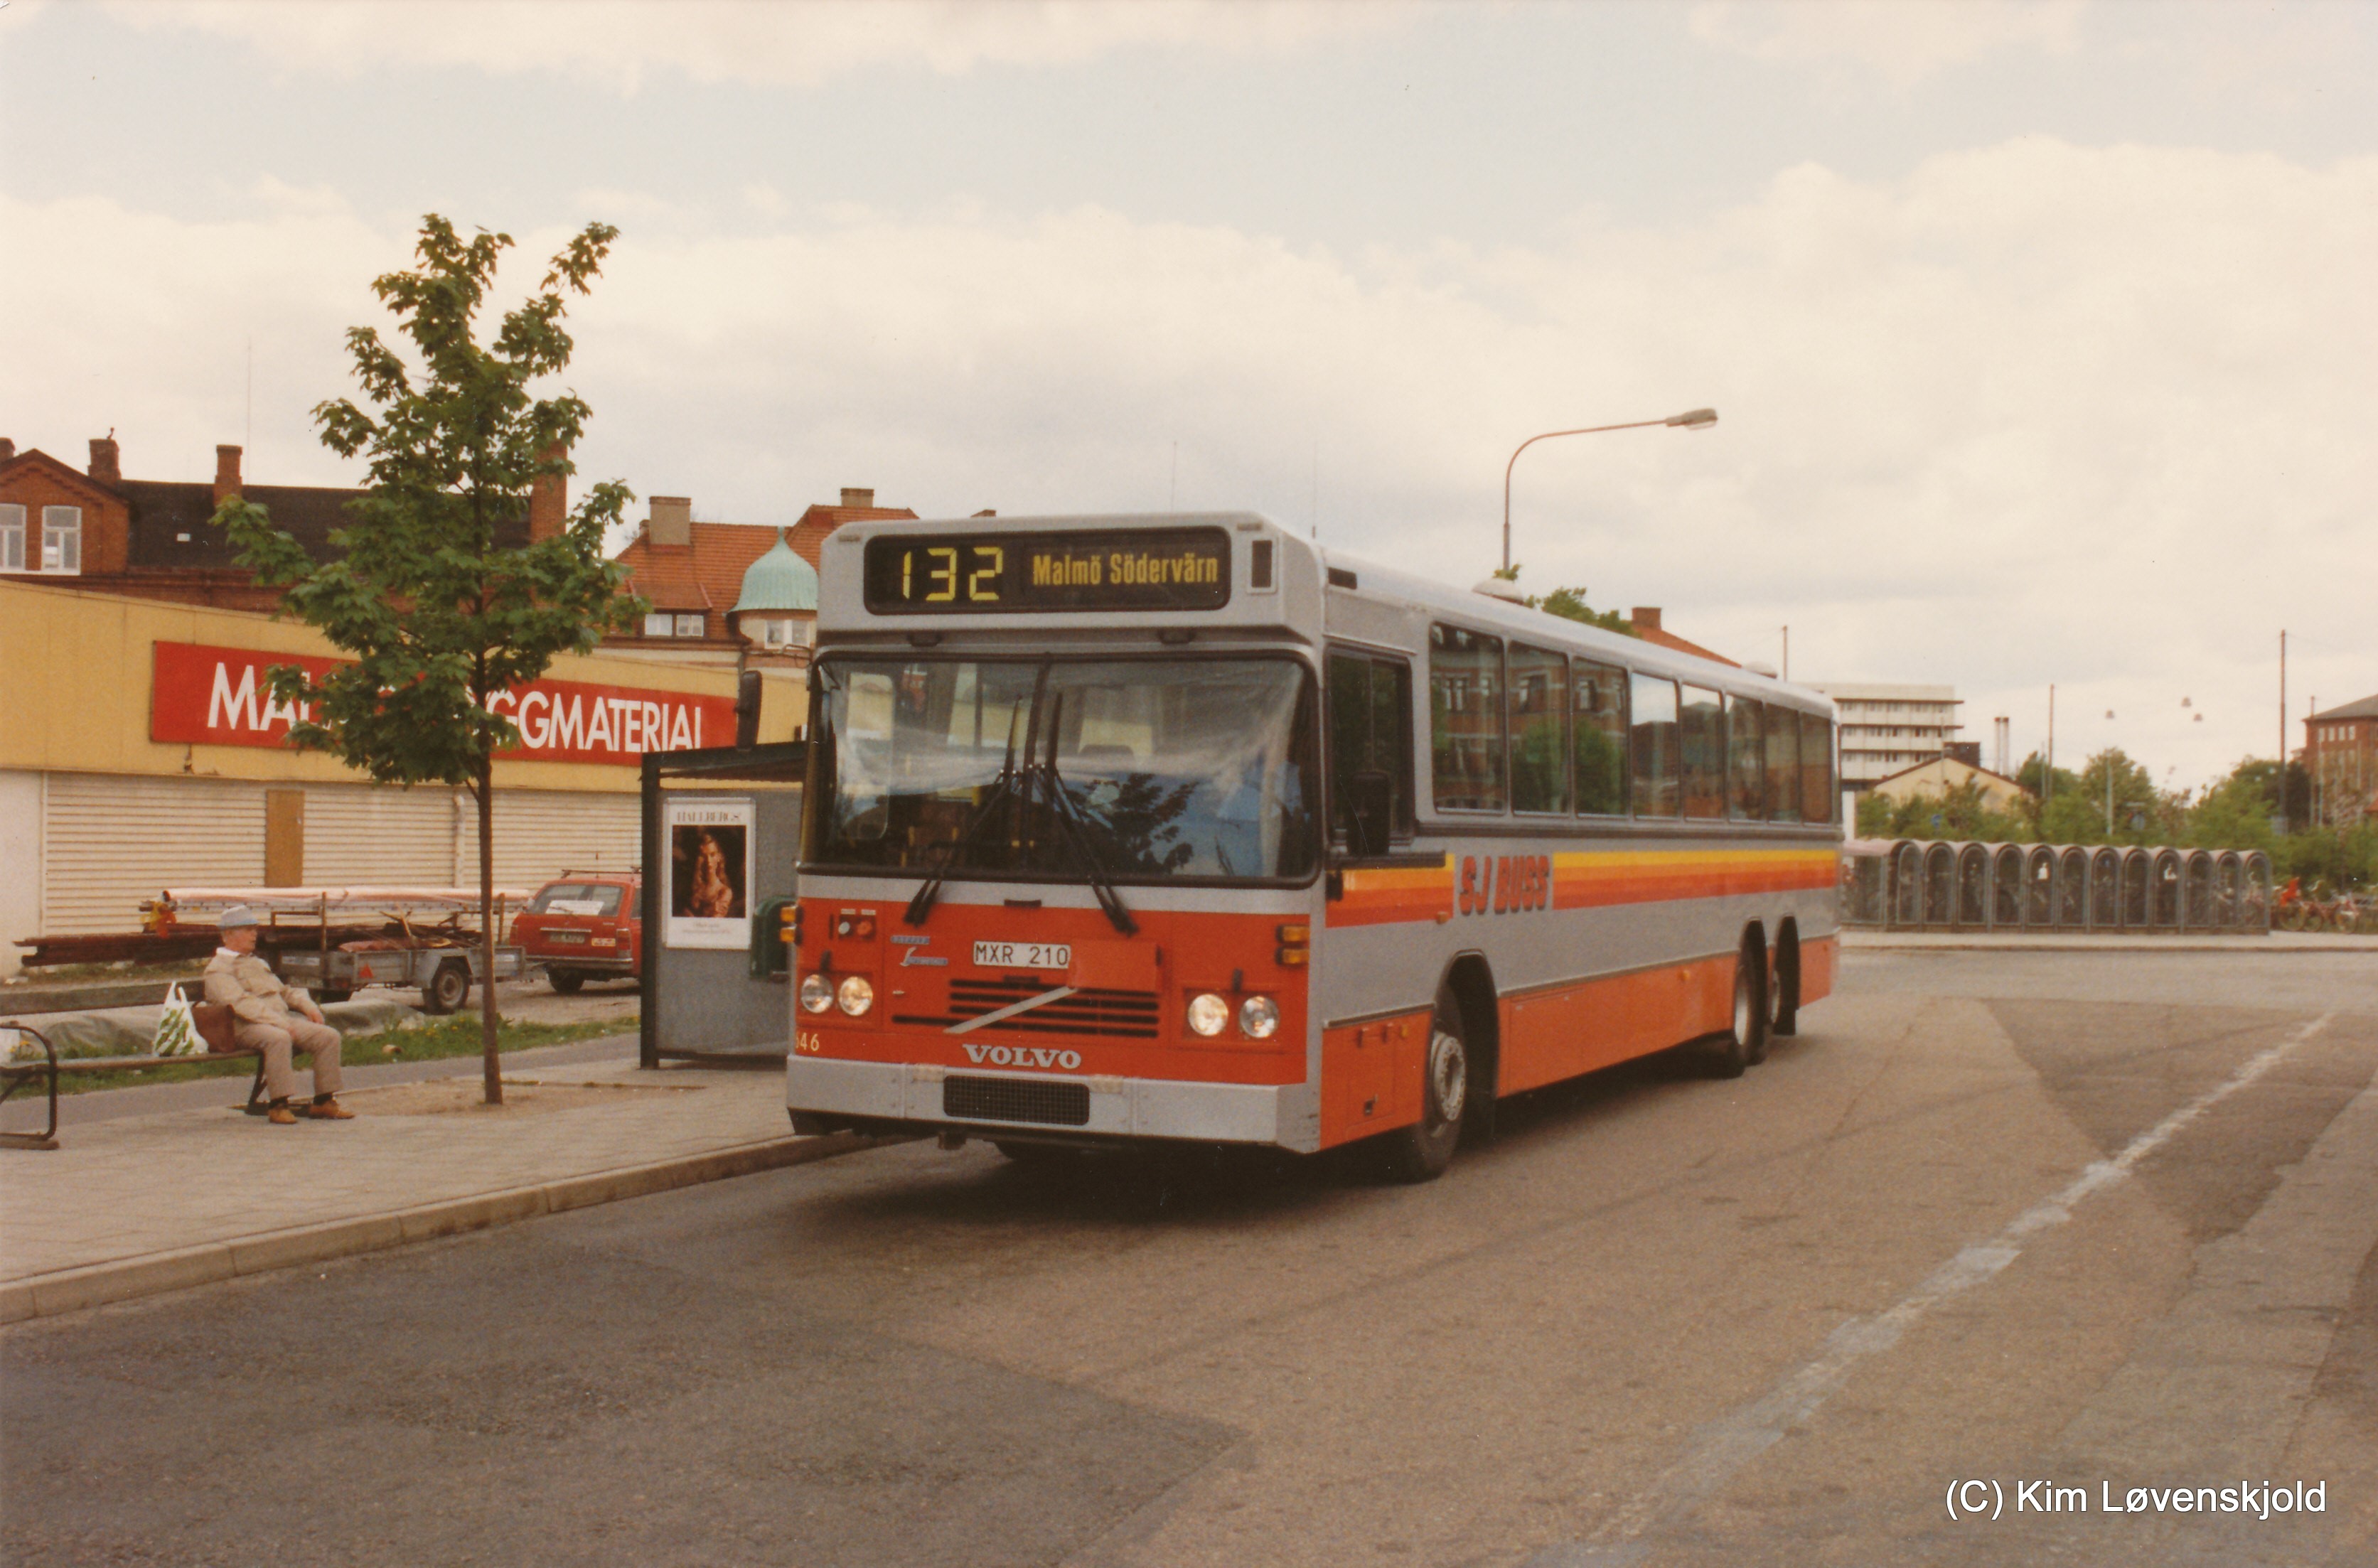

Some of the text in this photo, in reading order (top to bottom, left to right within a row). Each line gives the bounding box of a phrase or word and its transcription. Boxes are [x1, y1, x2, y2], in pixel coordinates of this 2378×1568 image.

[902, 547, 1219, 601] 132 Malmö Södervärn
[1459, 854, 1549, 916] SJ BUSS
[975, 943, 1069, 966] MXR 210
[962, 1043, 1082, 1070] VOLVO
